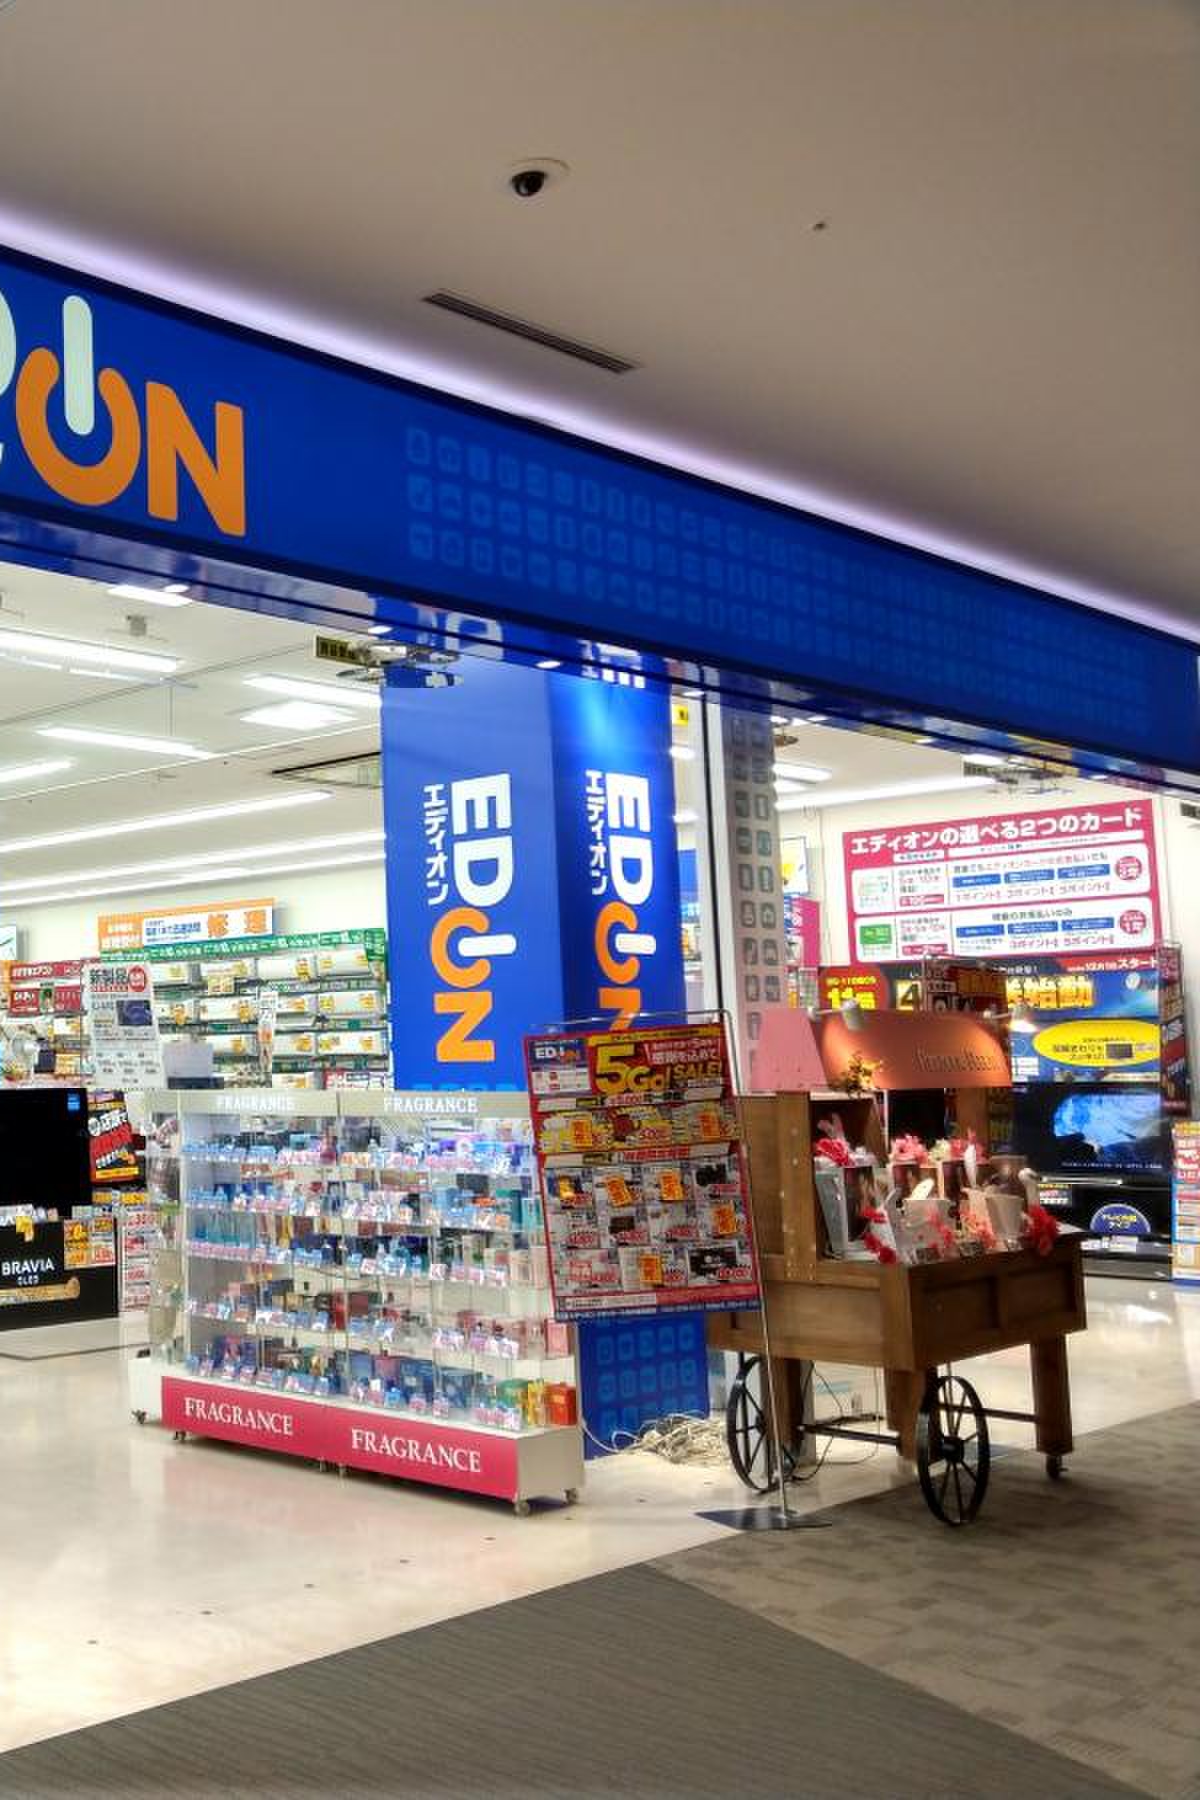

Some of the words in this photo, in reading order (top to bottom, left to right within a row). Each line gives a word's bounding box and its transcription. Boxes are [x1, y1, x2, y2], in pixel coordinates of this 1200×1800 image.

[423, 783, 451, 906] エディオン
[585, 769, 610, 896] エディオン
[851, 807, 1143, 854] エディオンの選べる2つのカード
[431, 772, 517, 1062] EDION
[383, 1096, 478, 1113] FRAGRANCE
[1, 1258, 55, 1276] BRAVIA
[183, 1396, 294, 1436] FRAGRANCE
[351, 1428, 482, 1474] FRAGRANCE
